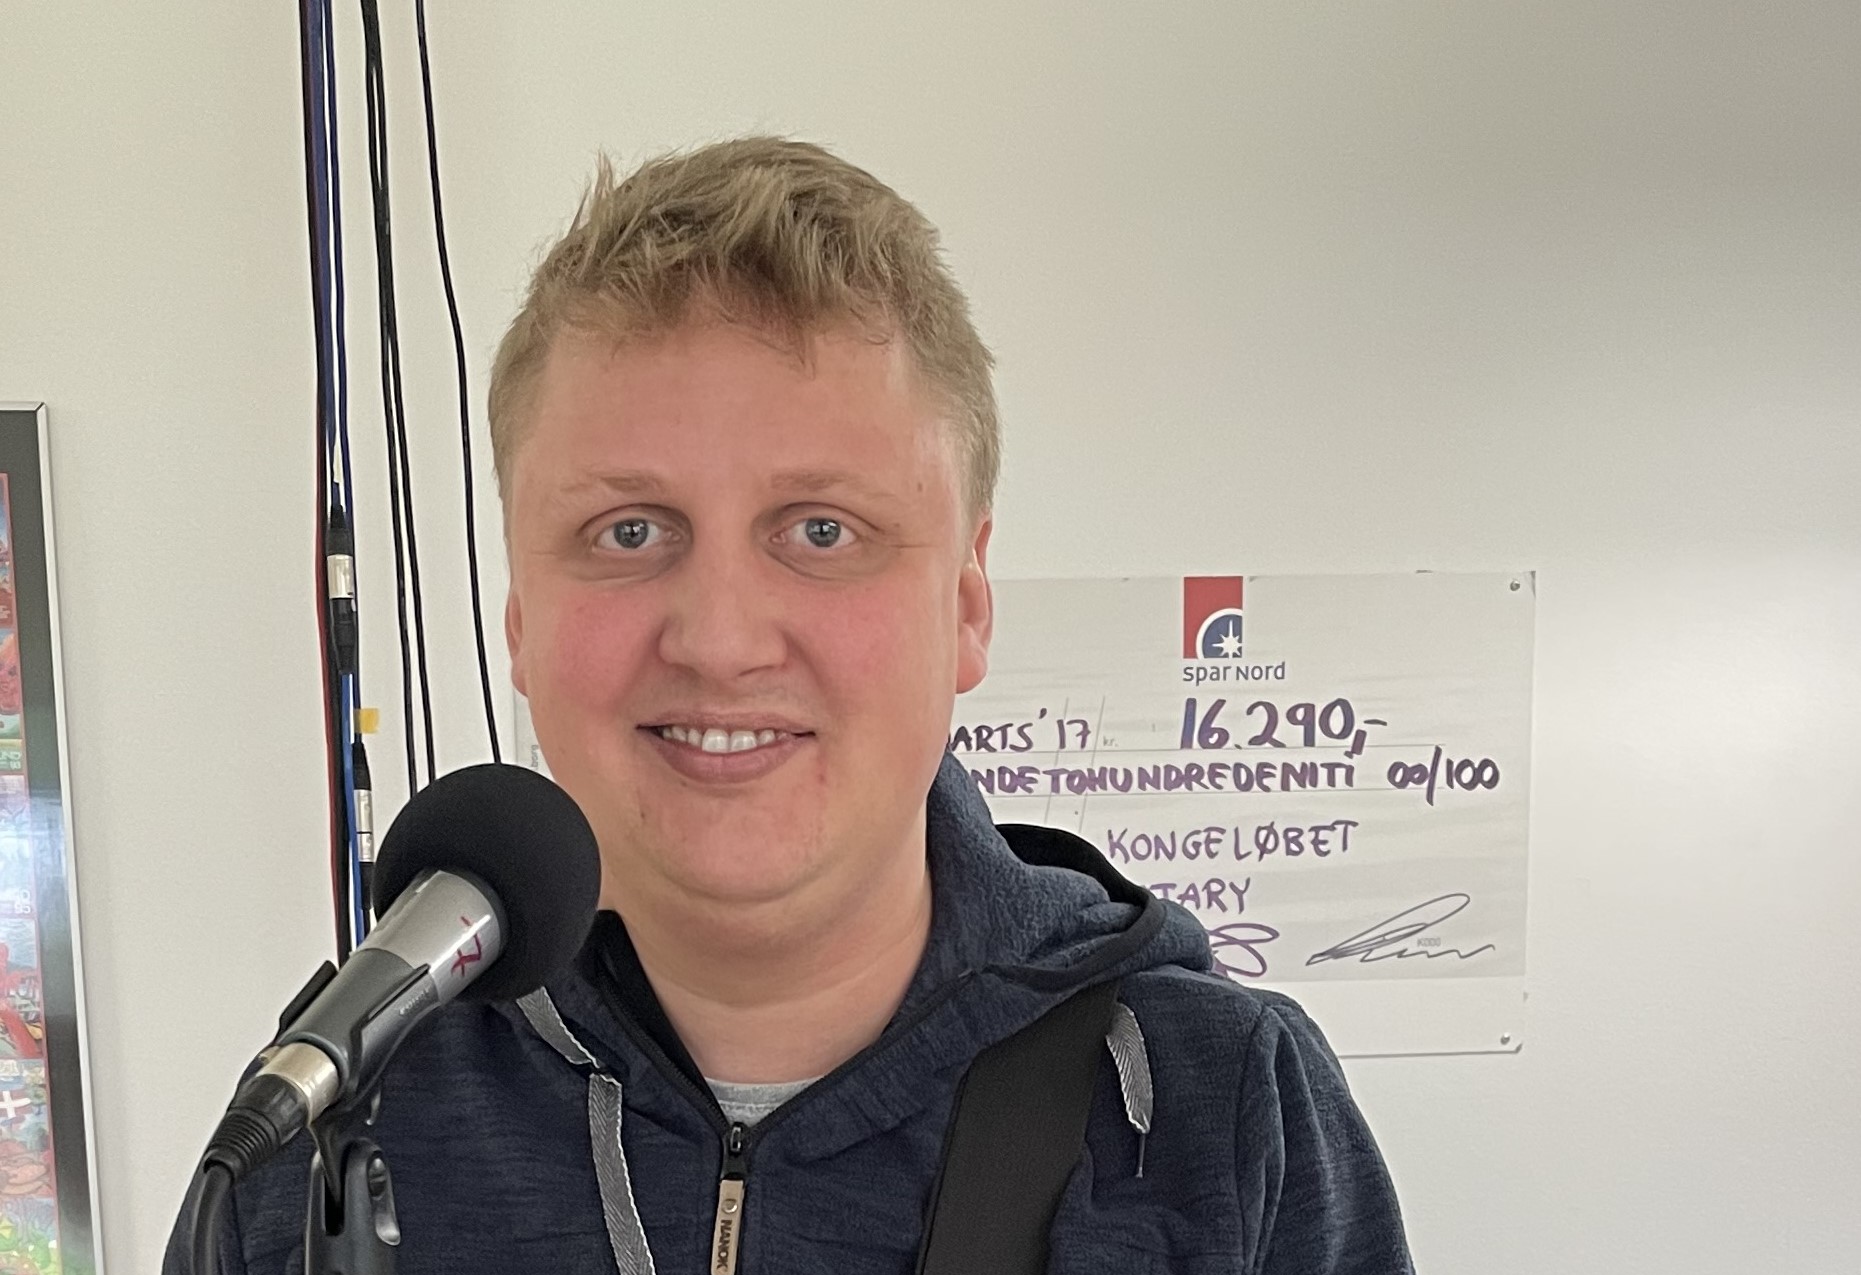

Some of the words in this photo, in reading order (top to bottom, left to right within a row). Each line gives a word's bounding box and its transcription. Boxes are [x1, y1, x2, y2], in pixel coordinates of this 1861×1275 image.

[947, 722, 1033, 752] ARTS
[970, 761, 1355, 795] NDETOHUNDREDENITI
[1150, 877, 1251, 914] TARY
